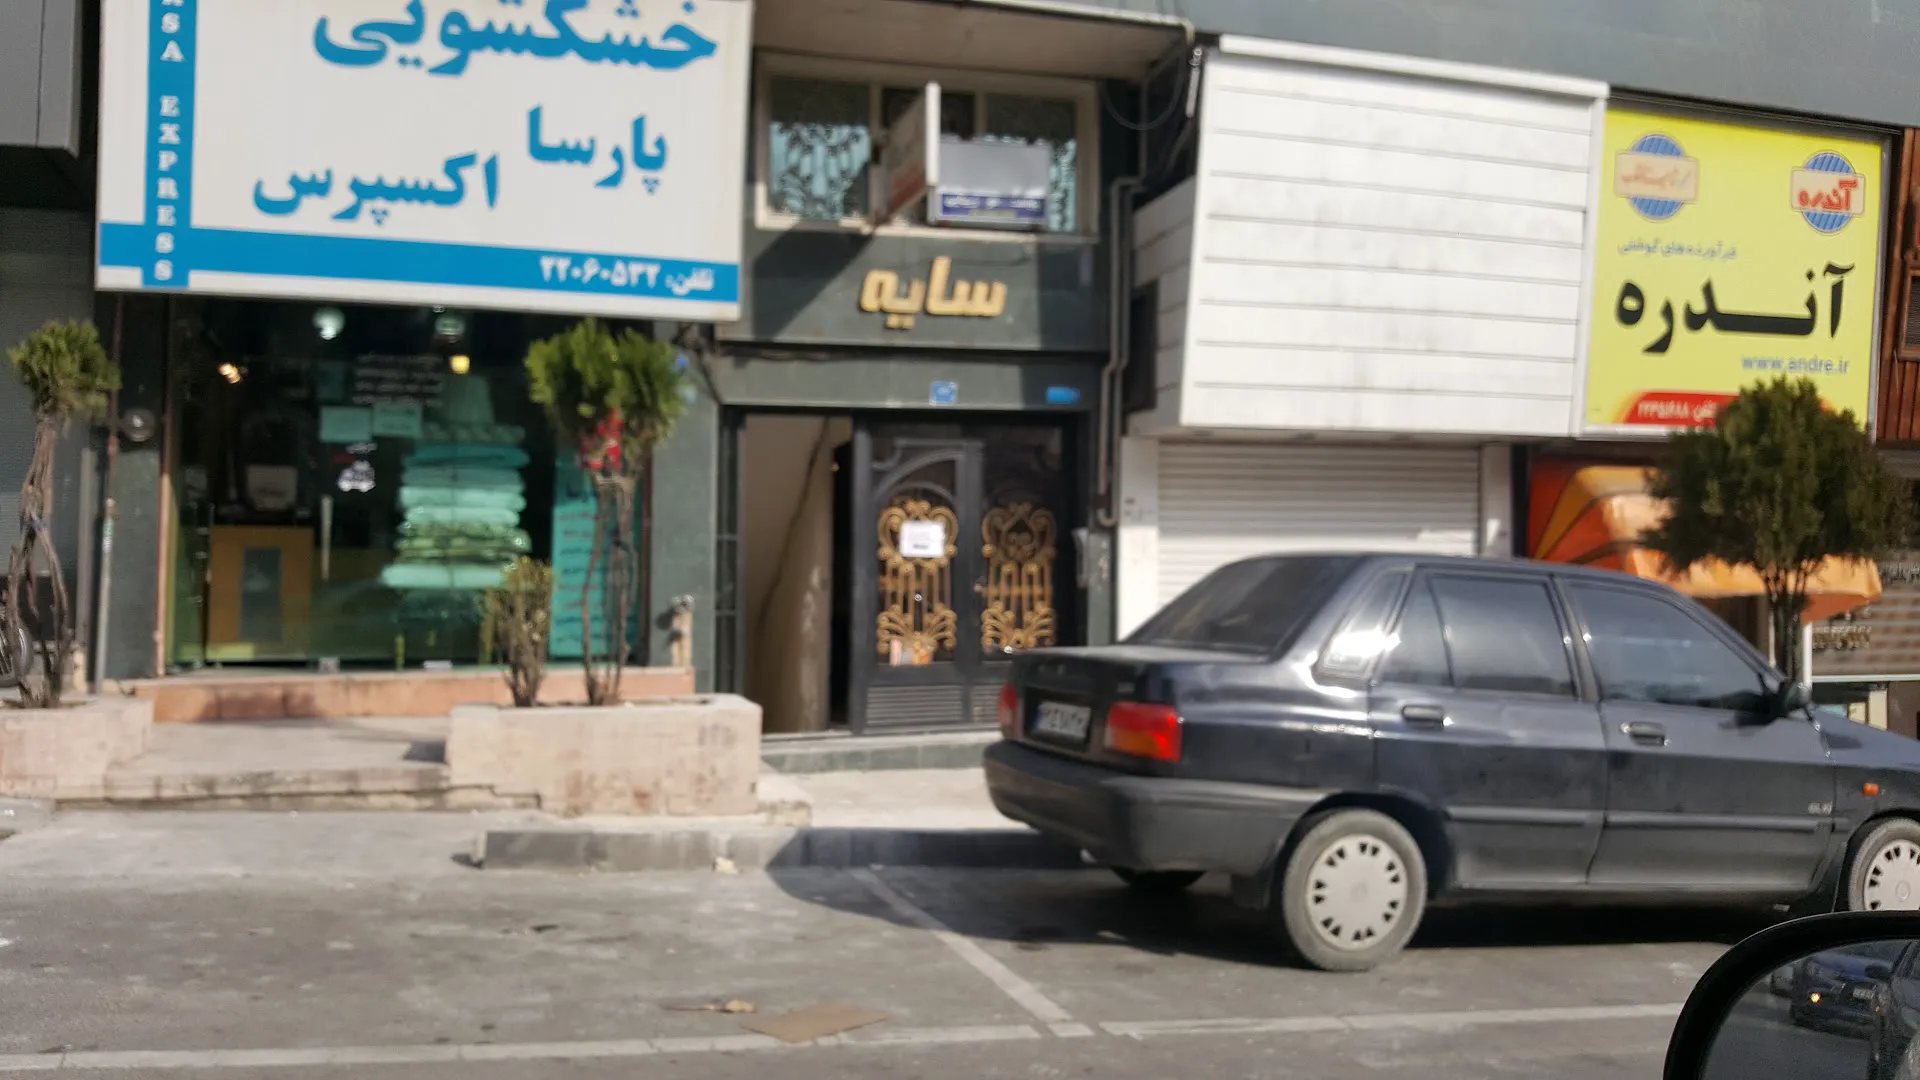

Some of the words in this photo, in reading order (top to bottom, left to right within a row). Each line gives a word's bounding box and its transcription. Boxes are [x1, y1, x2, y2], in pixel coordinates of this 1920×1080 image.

[160, 0, 186, 63] SA
[314, 0, 718, 76] خشکشویی
[527, 104, 668, 195] پارسا
[153, 95, 181, 282] EXPRESS
[253, 152, 499, 226] اکسپرس
[1797, 178, 1858, 211] آندره
[859, 254, 1008, 330] سایه
[1615, 262, 1855, 356] آندره
[1741, 355, 1849, 374] www.andre.ir
